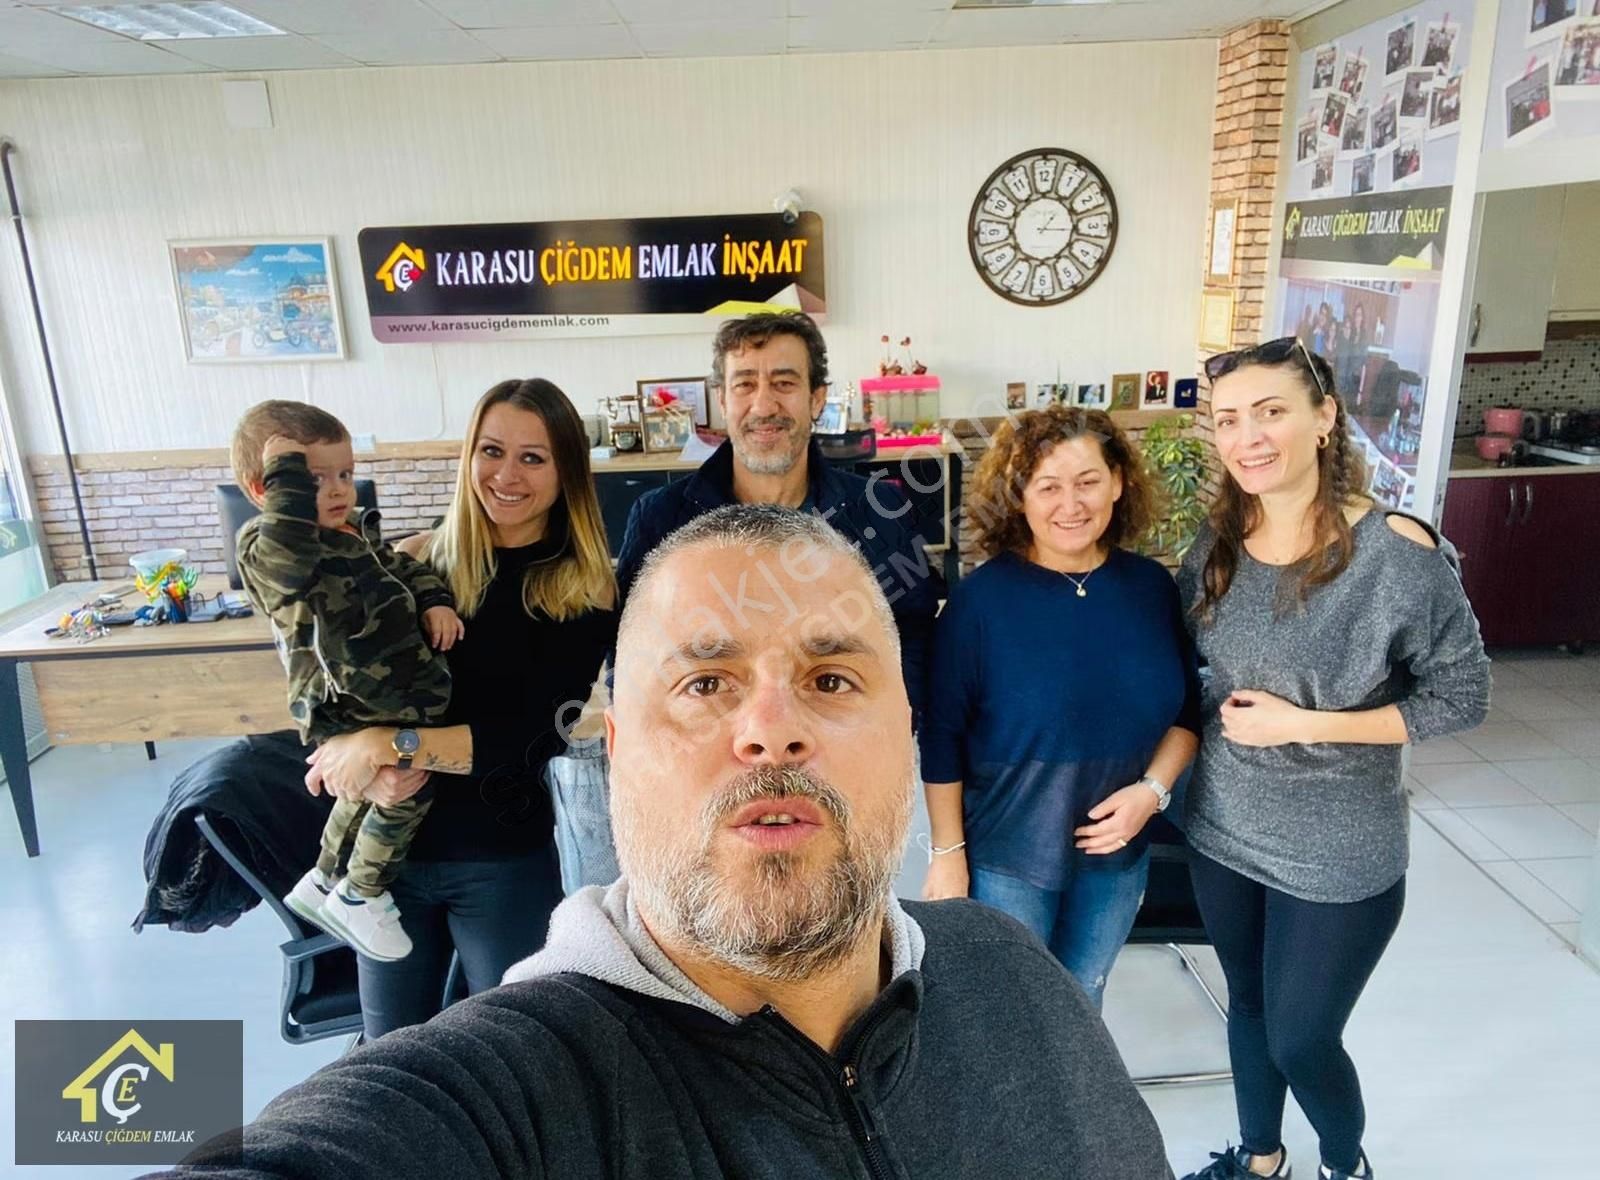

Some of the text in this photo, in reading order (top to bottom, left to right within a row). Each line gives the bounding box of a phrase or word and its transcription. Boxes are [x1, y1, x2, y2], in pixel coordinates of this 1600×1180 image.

[1039, 171, 1050, 183] 12
[1066, 176, 1073, 187] 1
[1013, 179, 1025, 191] 11
[995, 200, 1007, 211] 10
[1082, 195, 1092, 205] 2
[1300, 215, 1334, 237] KARASU
[1367, 209, 1403, 234] EMLAK
[1403, 205, 1444, 239] İNŞAAT
[989, 228, 1000, 237] 9
[1080, 248, 1089, 258] 4
[436, 234, 807, 287] KARASU ÇİĞDEM EMLAK İNŞAAT
[1063, 267, 1072, 278] 5
[1039, 275, 1046, 286] 6
[387, 314, 610, 334] www.karasucigdememlak.com
